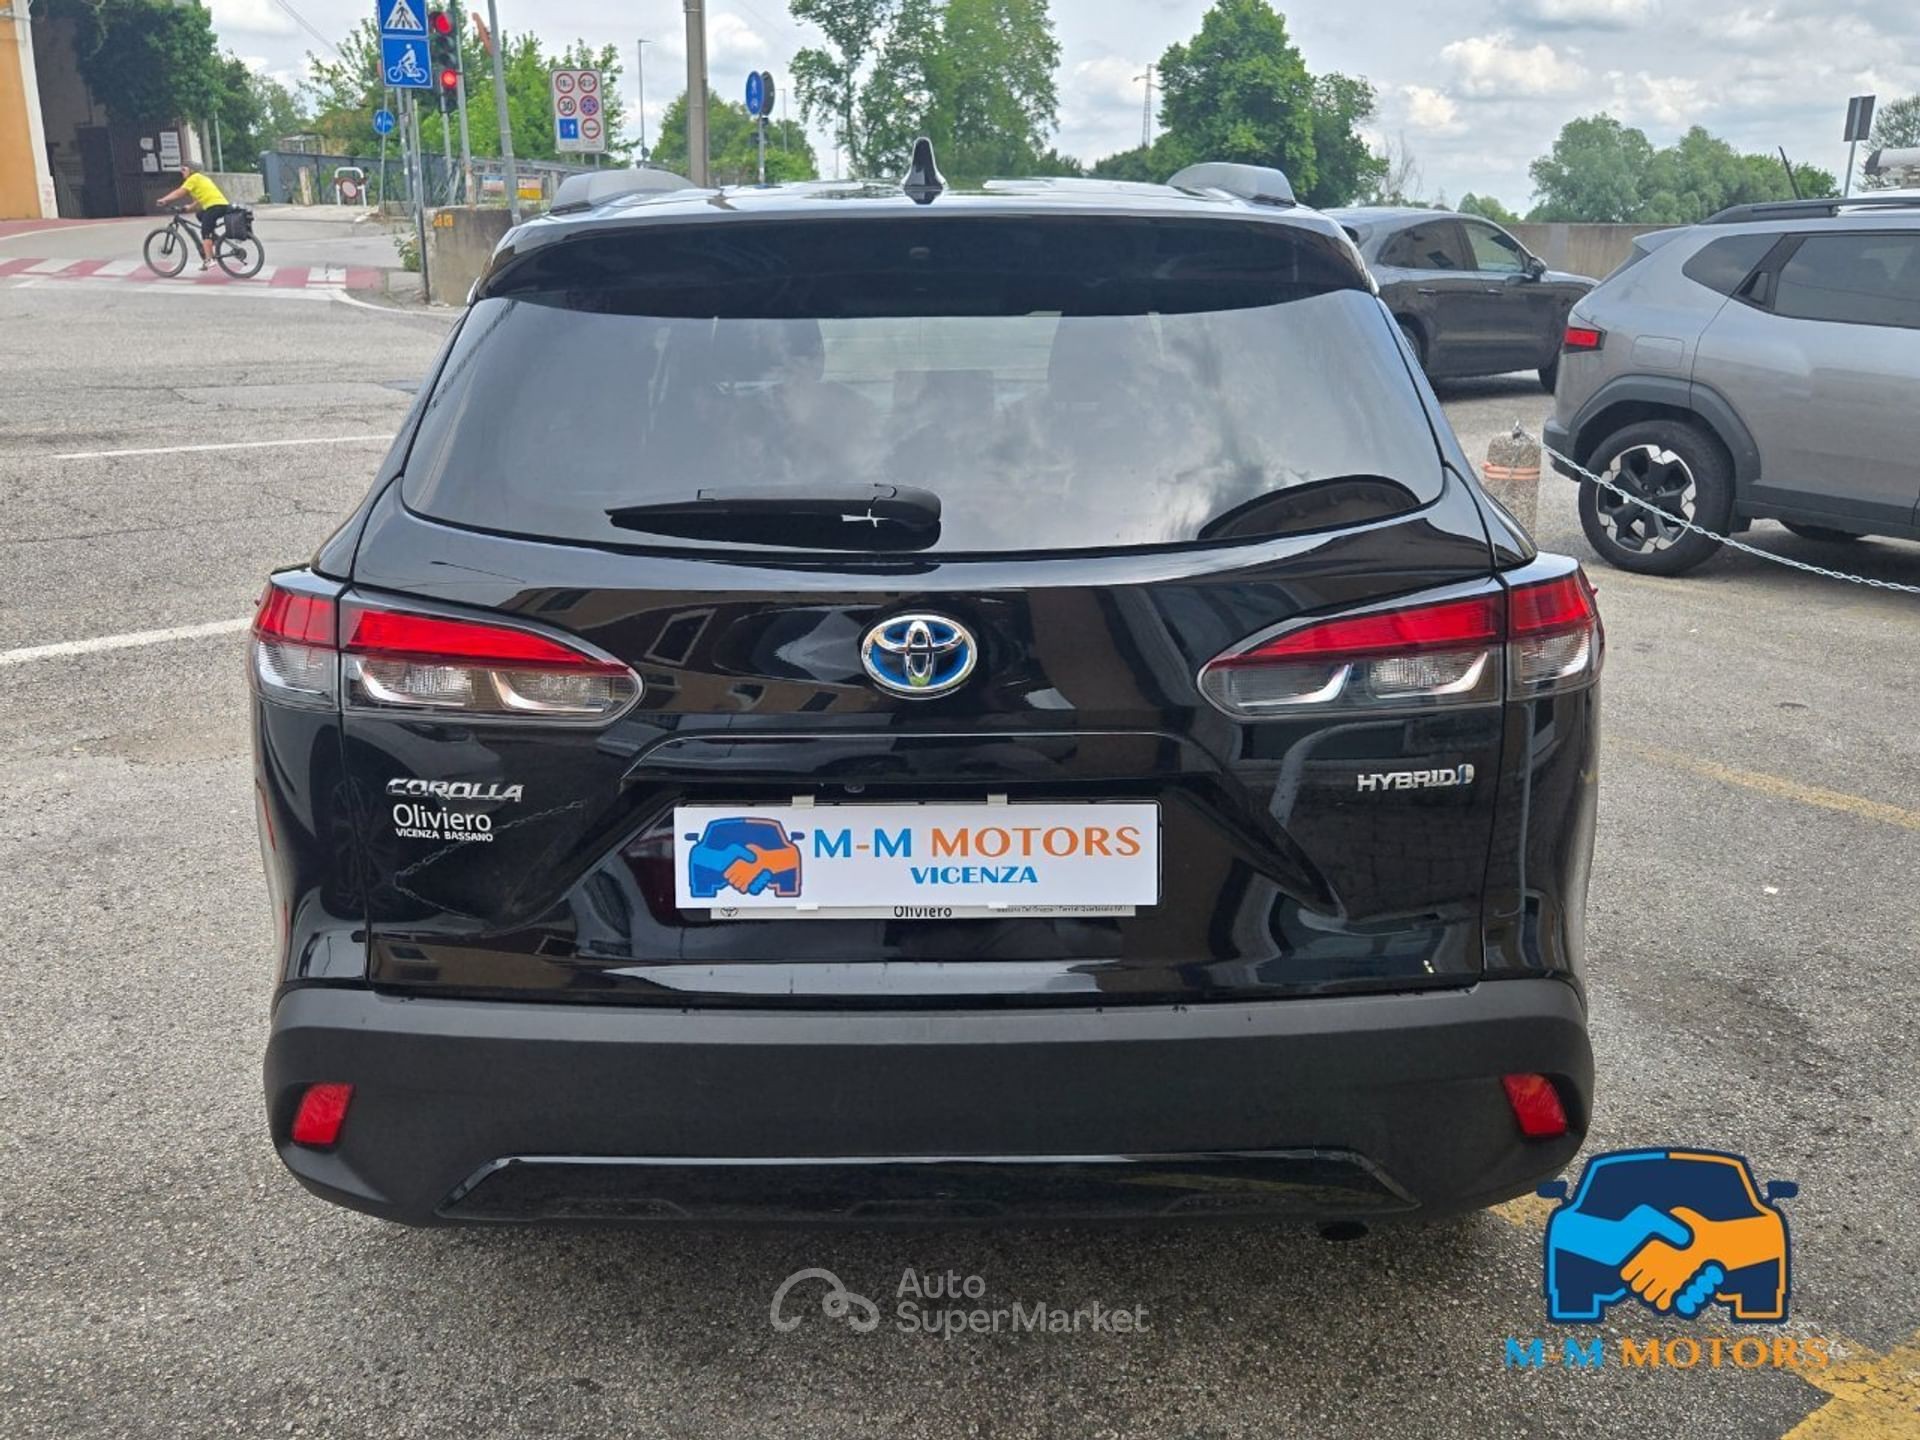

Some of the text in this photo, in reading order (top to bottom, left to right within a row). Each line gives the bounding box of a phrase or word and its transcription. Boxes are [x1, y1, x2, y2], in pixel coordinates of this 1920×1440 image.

[386, 778, 525, 802] COROLLA
[1357, 768, 1457, 792] HYBRID
[393, 803, 492, 832] Oliviero
[396, 828, 494, 842] VICENZA BASSANO
[814, 827, 1141, 858] M-M MOTORS
[910, 866, 1038, 885] VICENZA
[894, 905, 953, 918] Oliviero
